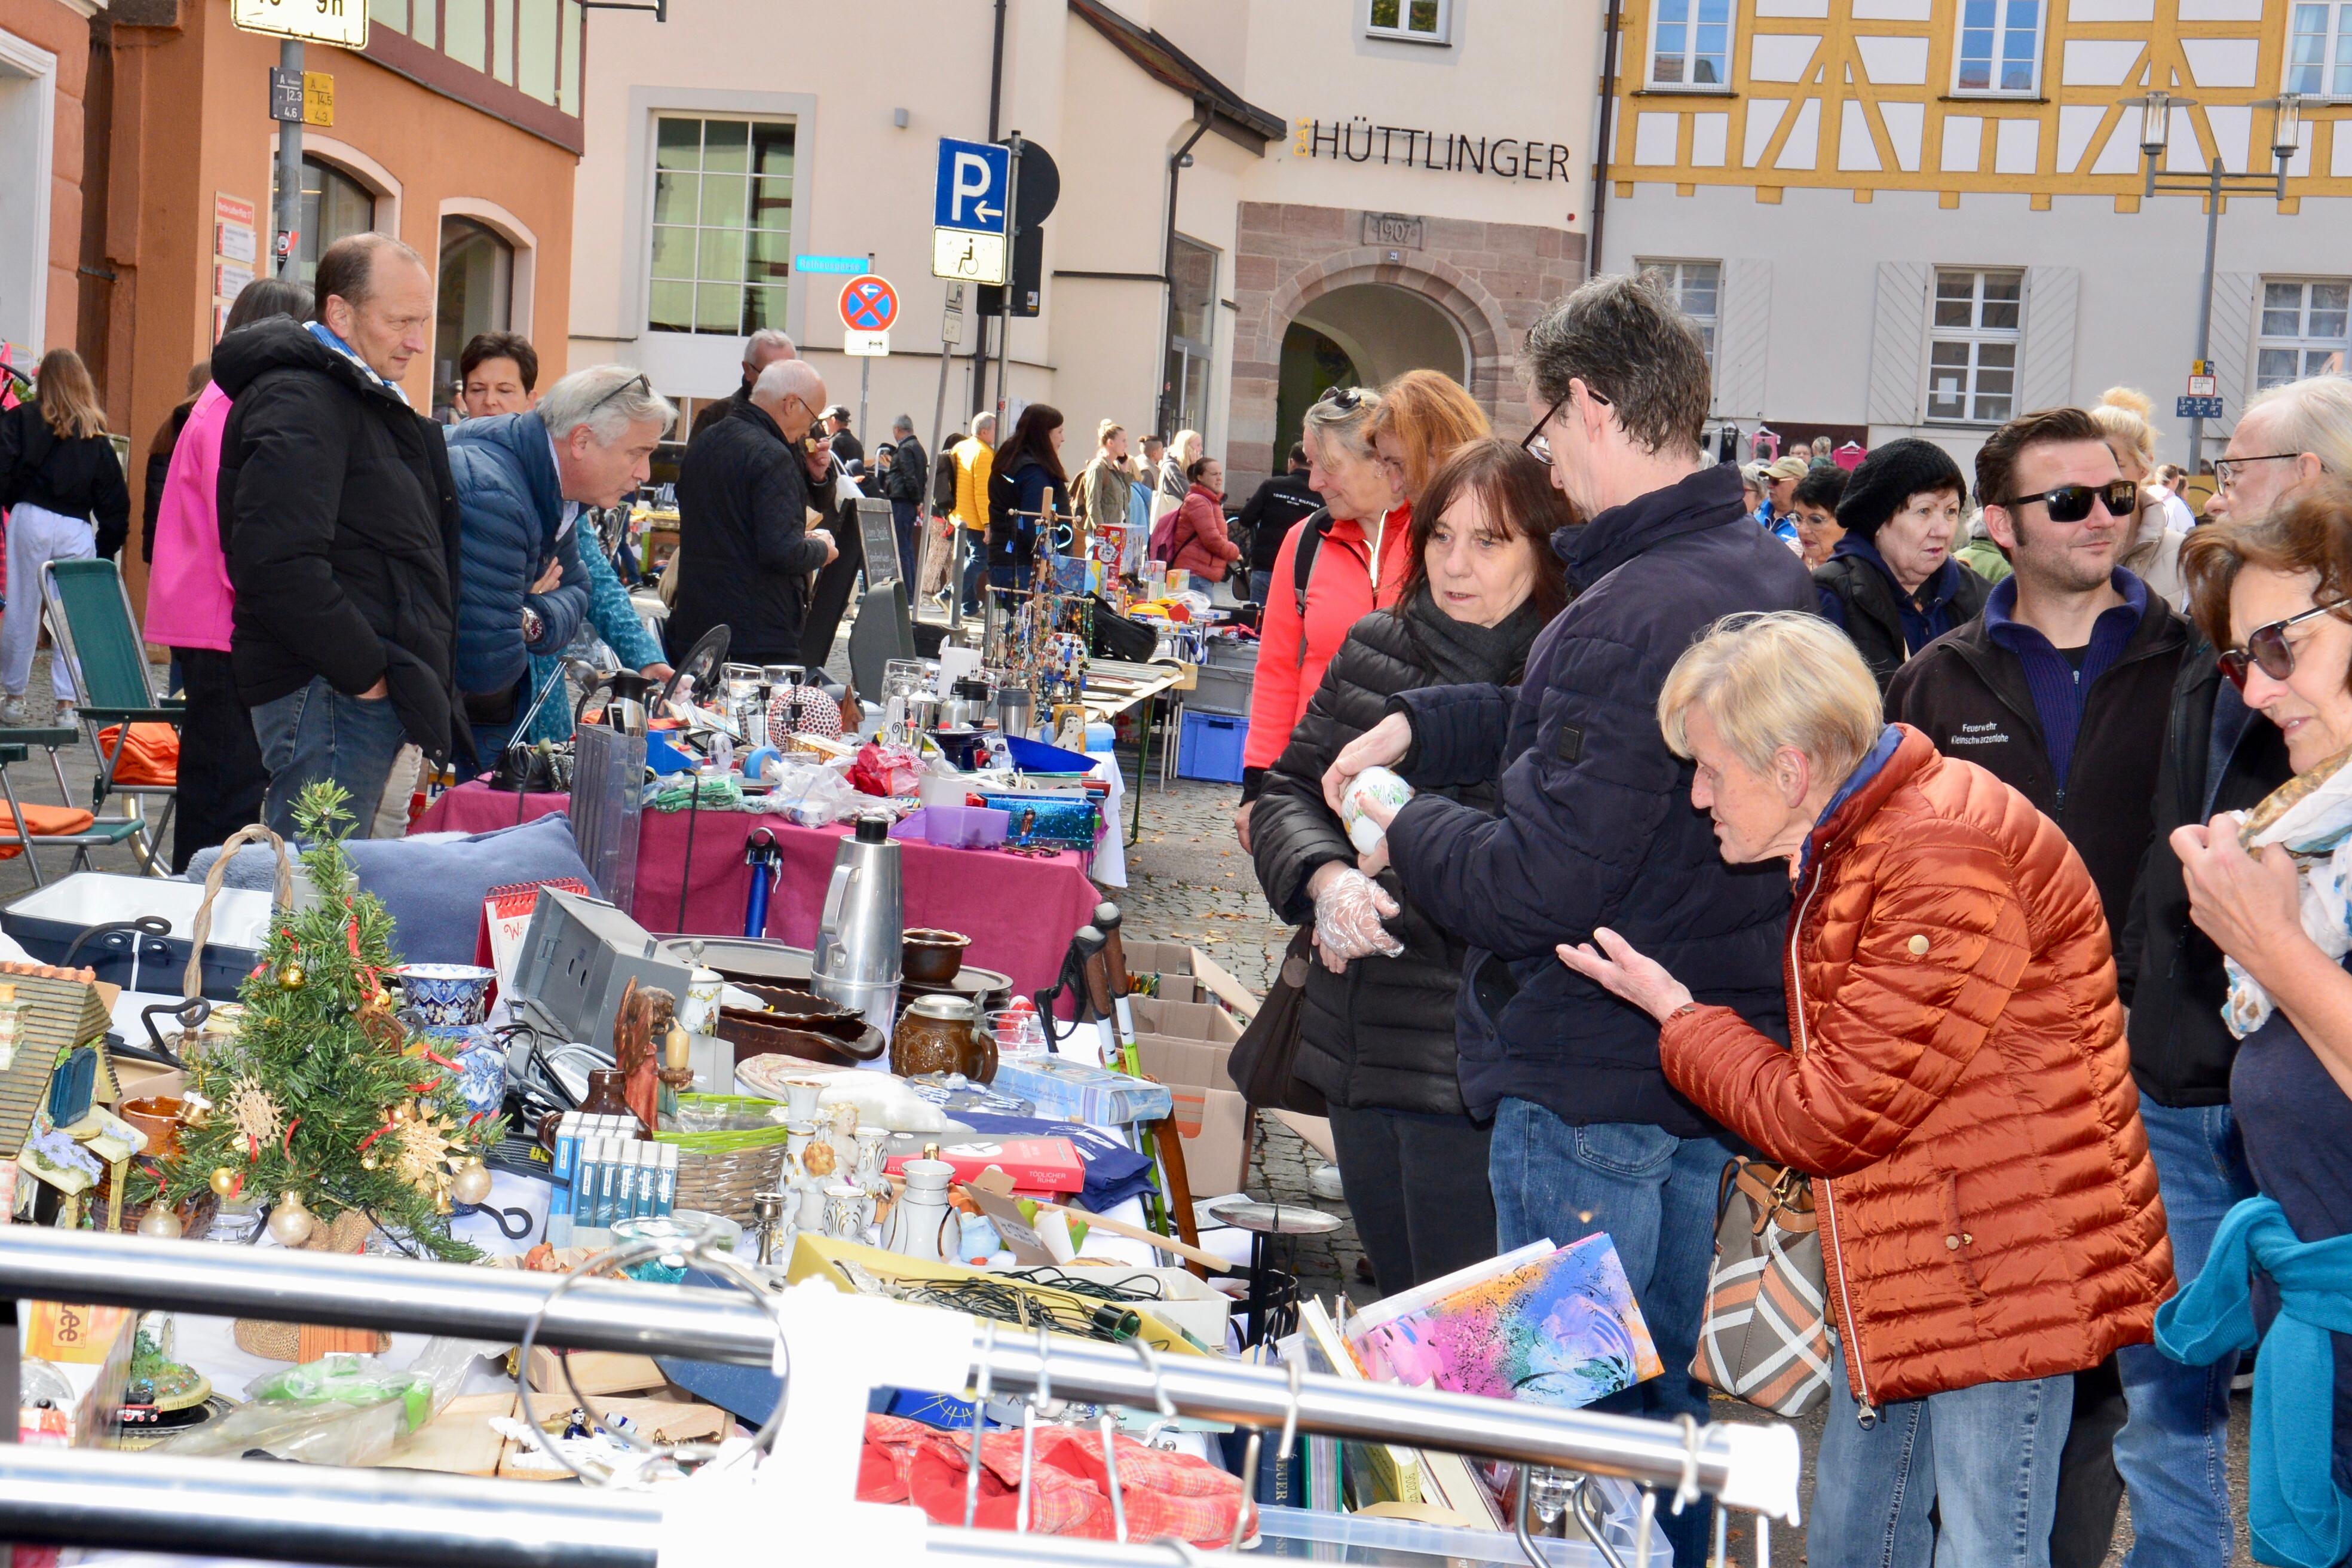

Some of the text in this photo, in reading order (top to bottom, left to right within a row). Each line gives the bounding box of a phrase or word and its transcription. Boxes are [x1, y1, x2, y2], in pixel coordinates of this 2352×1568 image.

[280, 74, 285, 84] A
[1293, 117, 1311, 157] DAS
[1312, 115, 1570, 183] HÜTTLINGER
[951, 151, 991, 222] P
[1962, 721, 1997, 733] Feuerwehr
[1951, 733, 2008, 745] Kleinschwarzenlohe
[1030, 1170, 1066, 1179] TÖDLICHER
[1405, 1473, 1417, 1493] 2006
